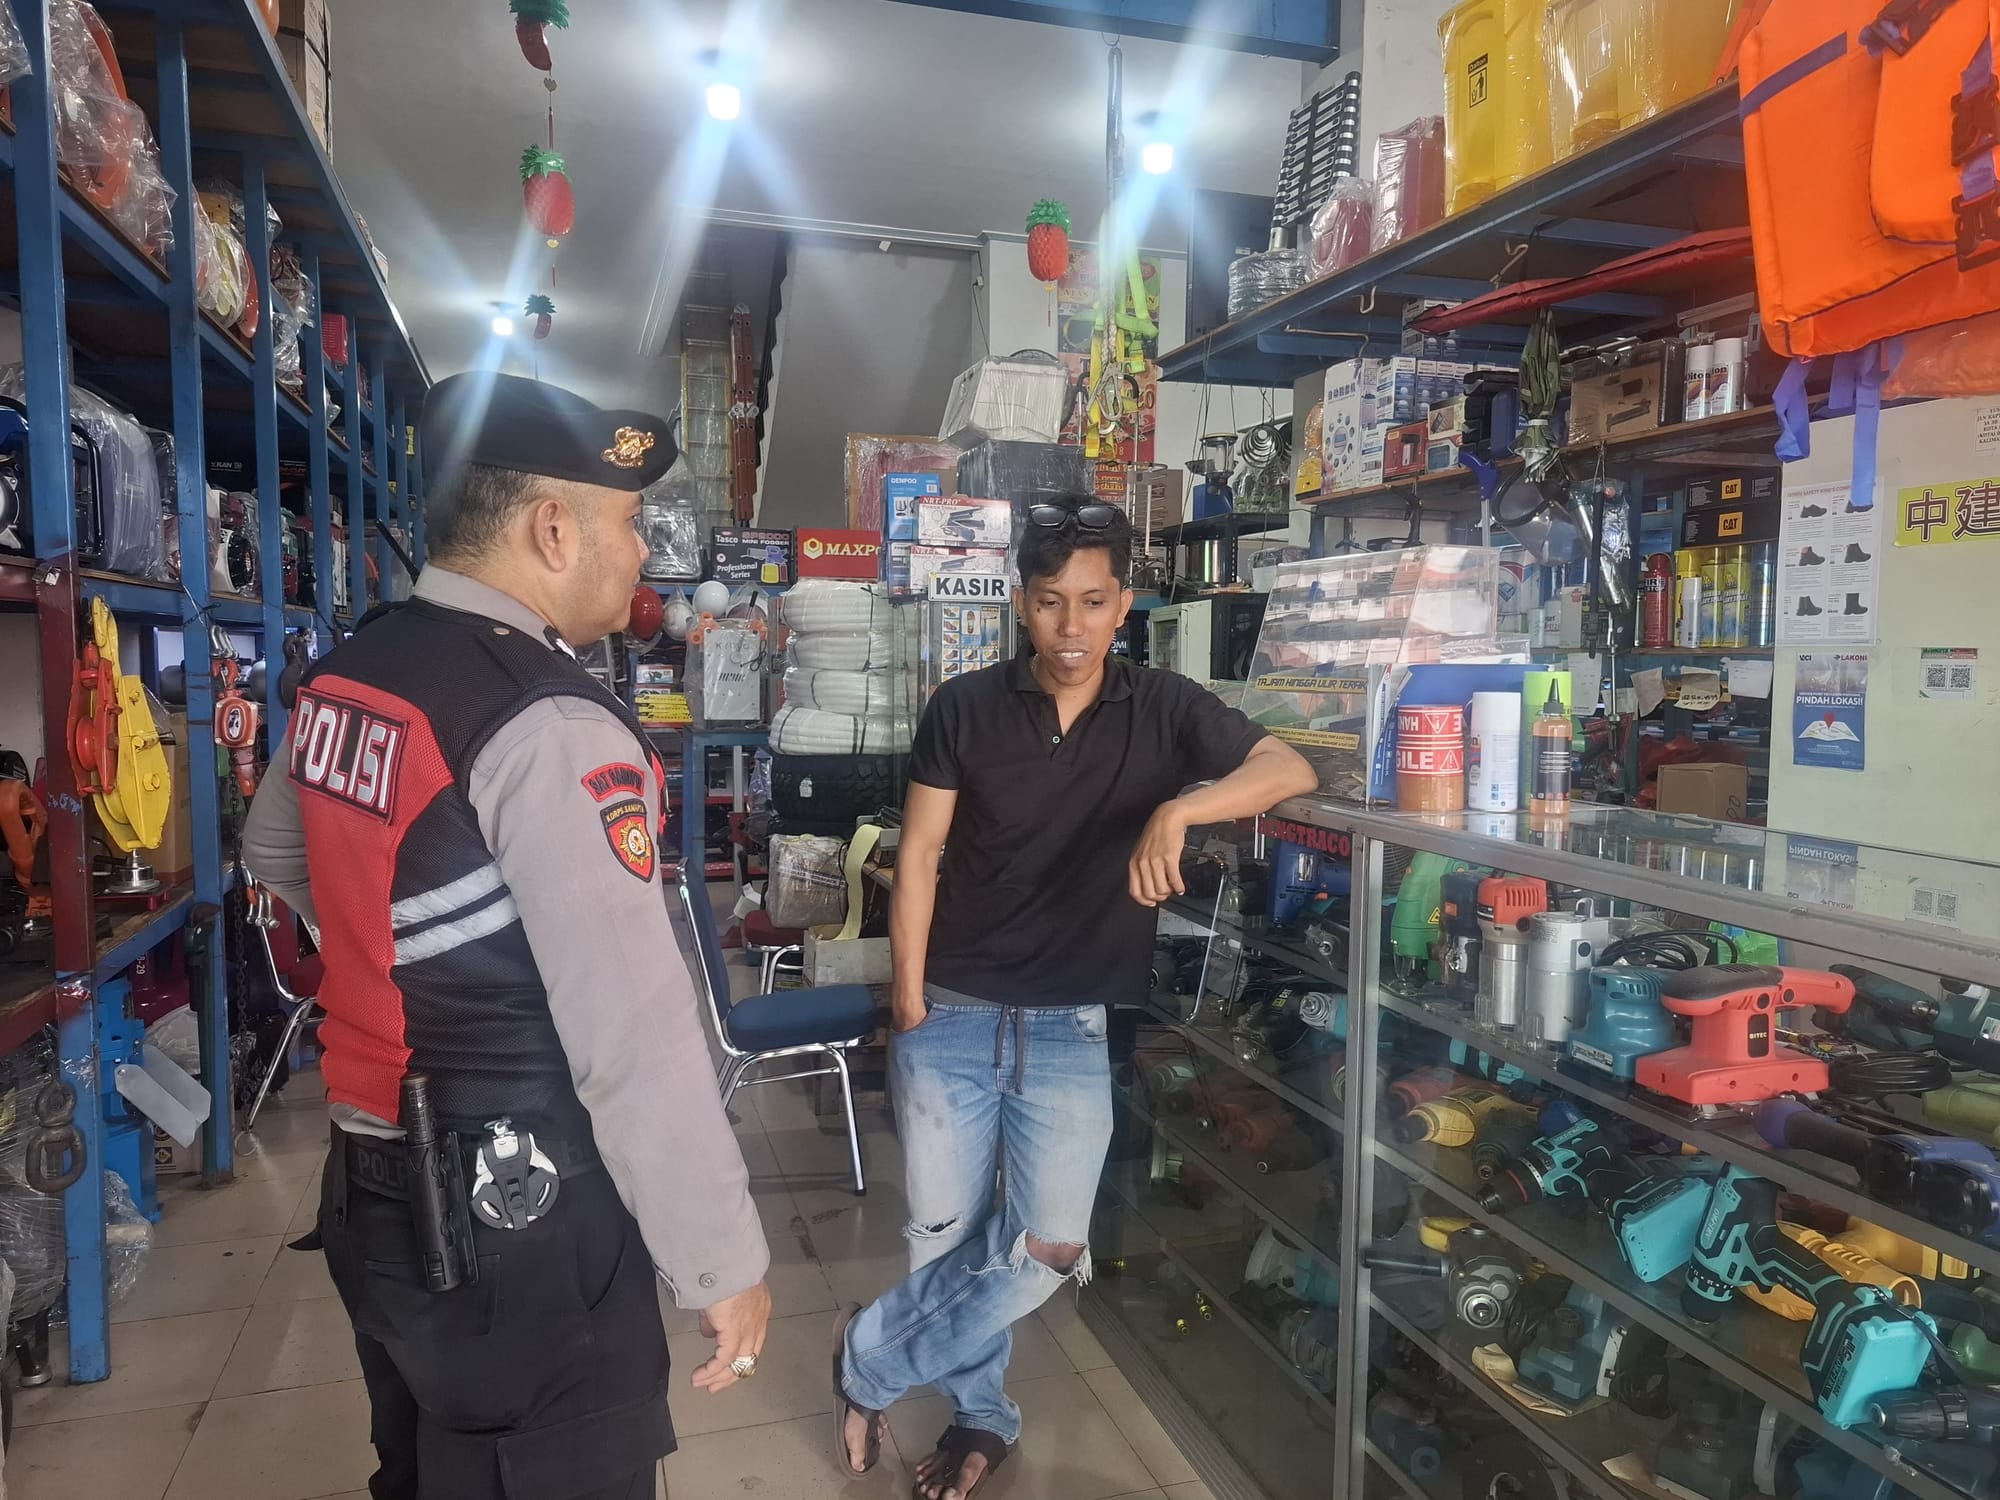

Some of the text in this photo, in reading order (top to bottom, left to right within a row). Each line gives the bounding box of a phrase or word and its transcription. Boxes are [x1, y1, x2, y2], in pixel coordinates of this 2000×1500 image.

[1725, 483, 1738, 495] CAT
[922, 496, 957, 505] NRT-PRO
[1905, 480, 2000, 542] 中建
[1723, 517, 1738, 531] CAT
[715, 534, 738, 543] Tasco
[717, 562, 758, 573] Professional
[730, 571, 750, 579] Series
[935, 577, 1005, 597] KASIR
[1257, 678, 1285, 686] TAJAM
[1286, 679, 1317, 688] HINGGA
[1318, 680, 1337, 689] ULIR
[1796, 696, 1830, 704] PINDAH
[290, 697, 399, 812] POLISI
[606, 808, 624, 822] KORPS
